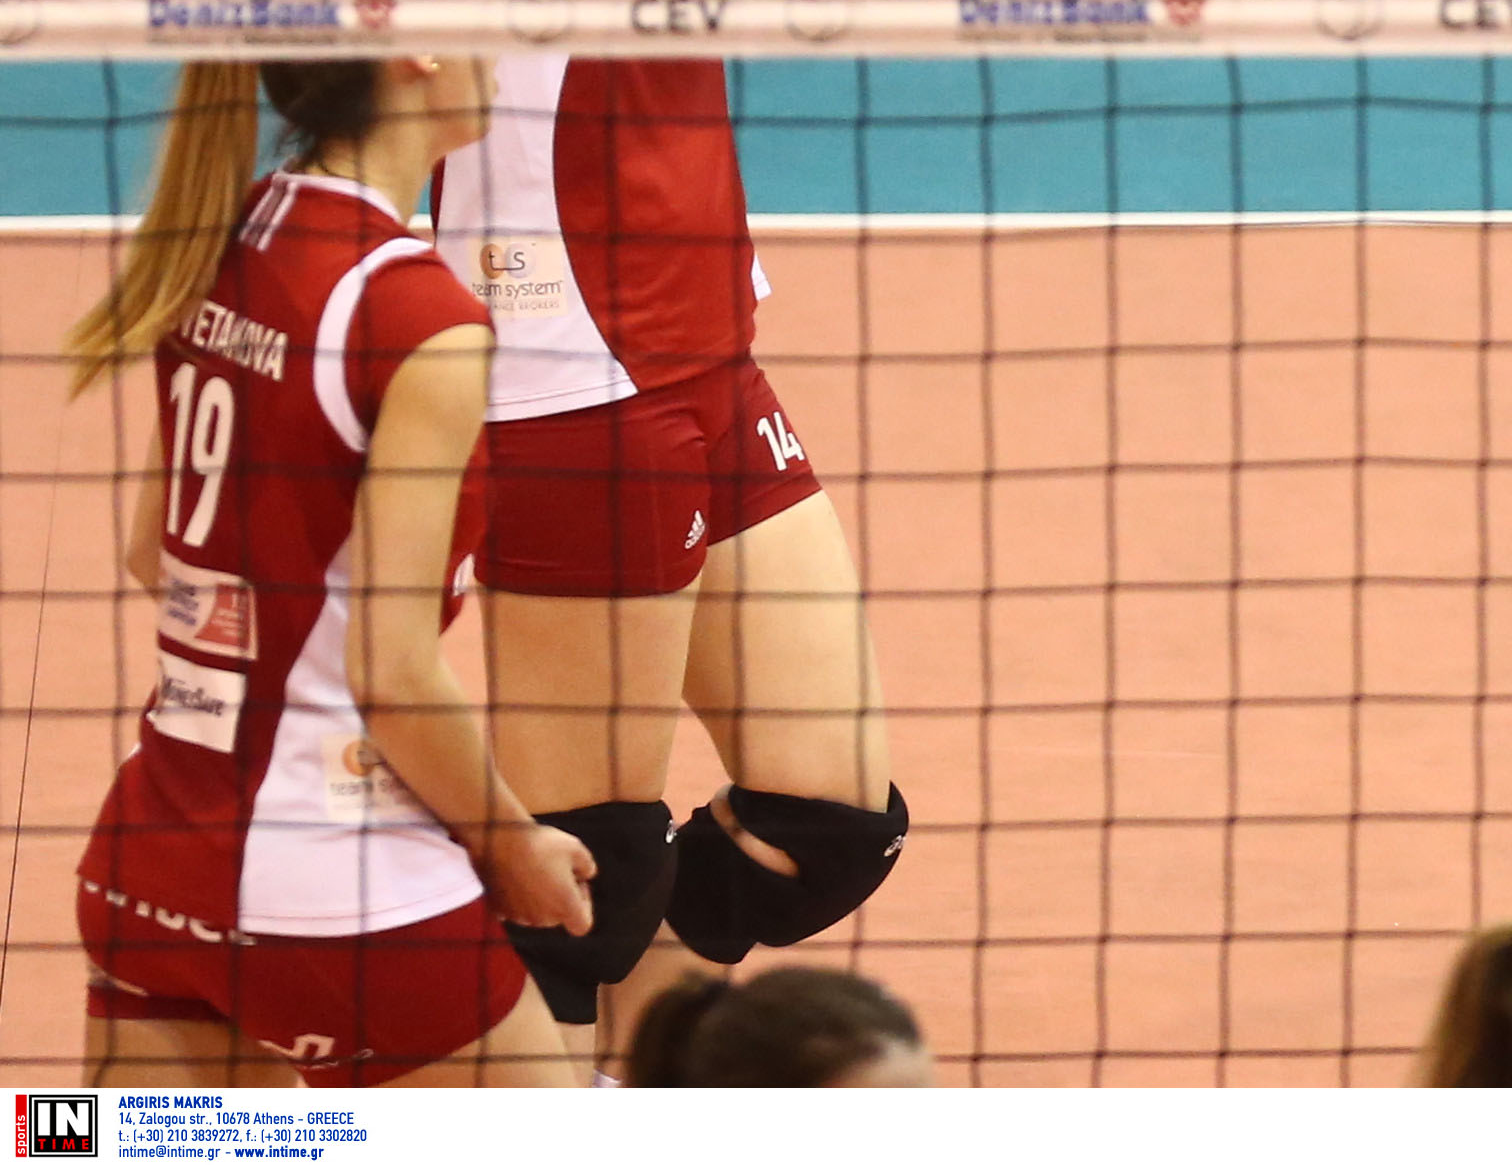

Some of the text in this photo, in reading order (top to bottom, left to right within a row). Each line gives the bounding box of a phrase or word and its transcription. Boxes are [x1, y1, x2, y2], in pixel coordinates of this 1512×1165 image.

[505, 280, 561, 300] system
[166, 361, 235, 549] 19
[756, 410, 806, 472] 14
